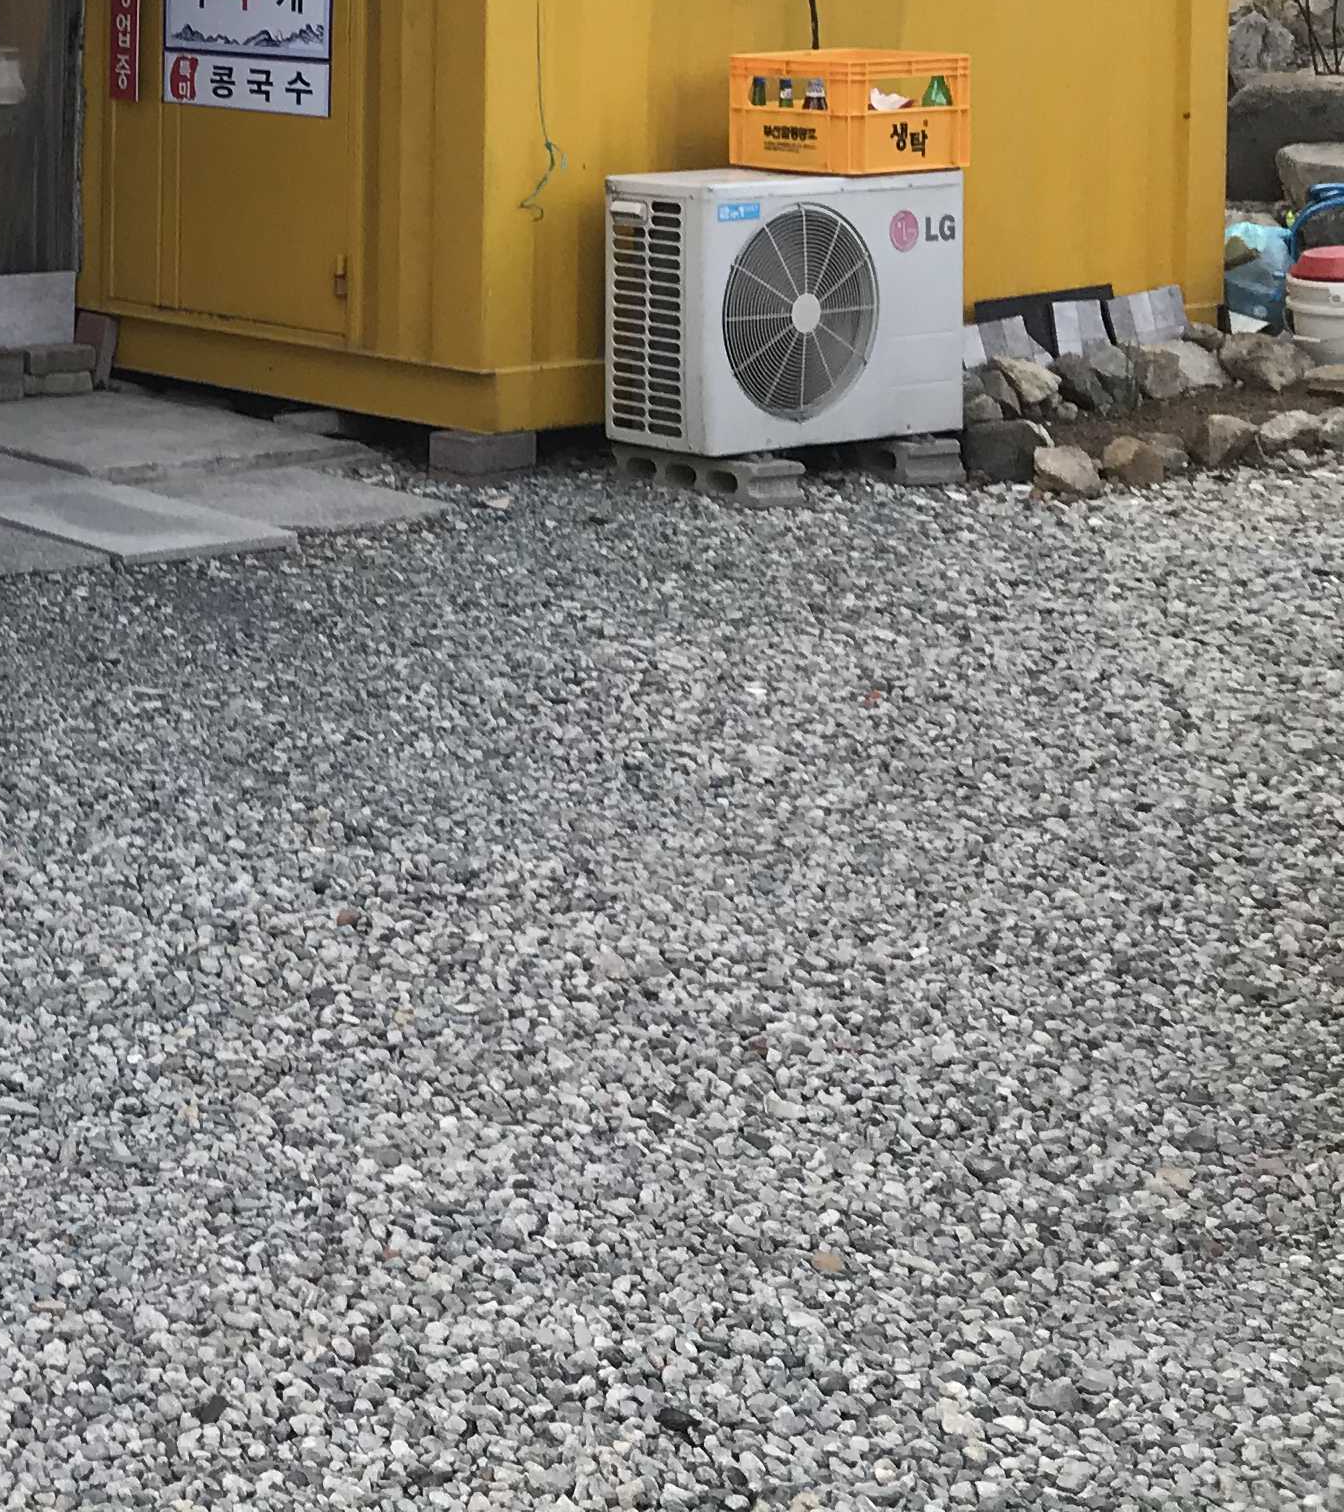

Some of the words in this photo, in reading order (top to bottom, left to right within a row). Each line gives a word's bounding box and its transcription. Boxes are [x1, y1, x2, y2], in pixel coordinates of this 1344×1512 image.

[210, 65, 313, 106] 콩국수
[890, 122, 929, 157] 생탁
[925, 214, 956, 242] LG
